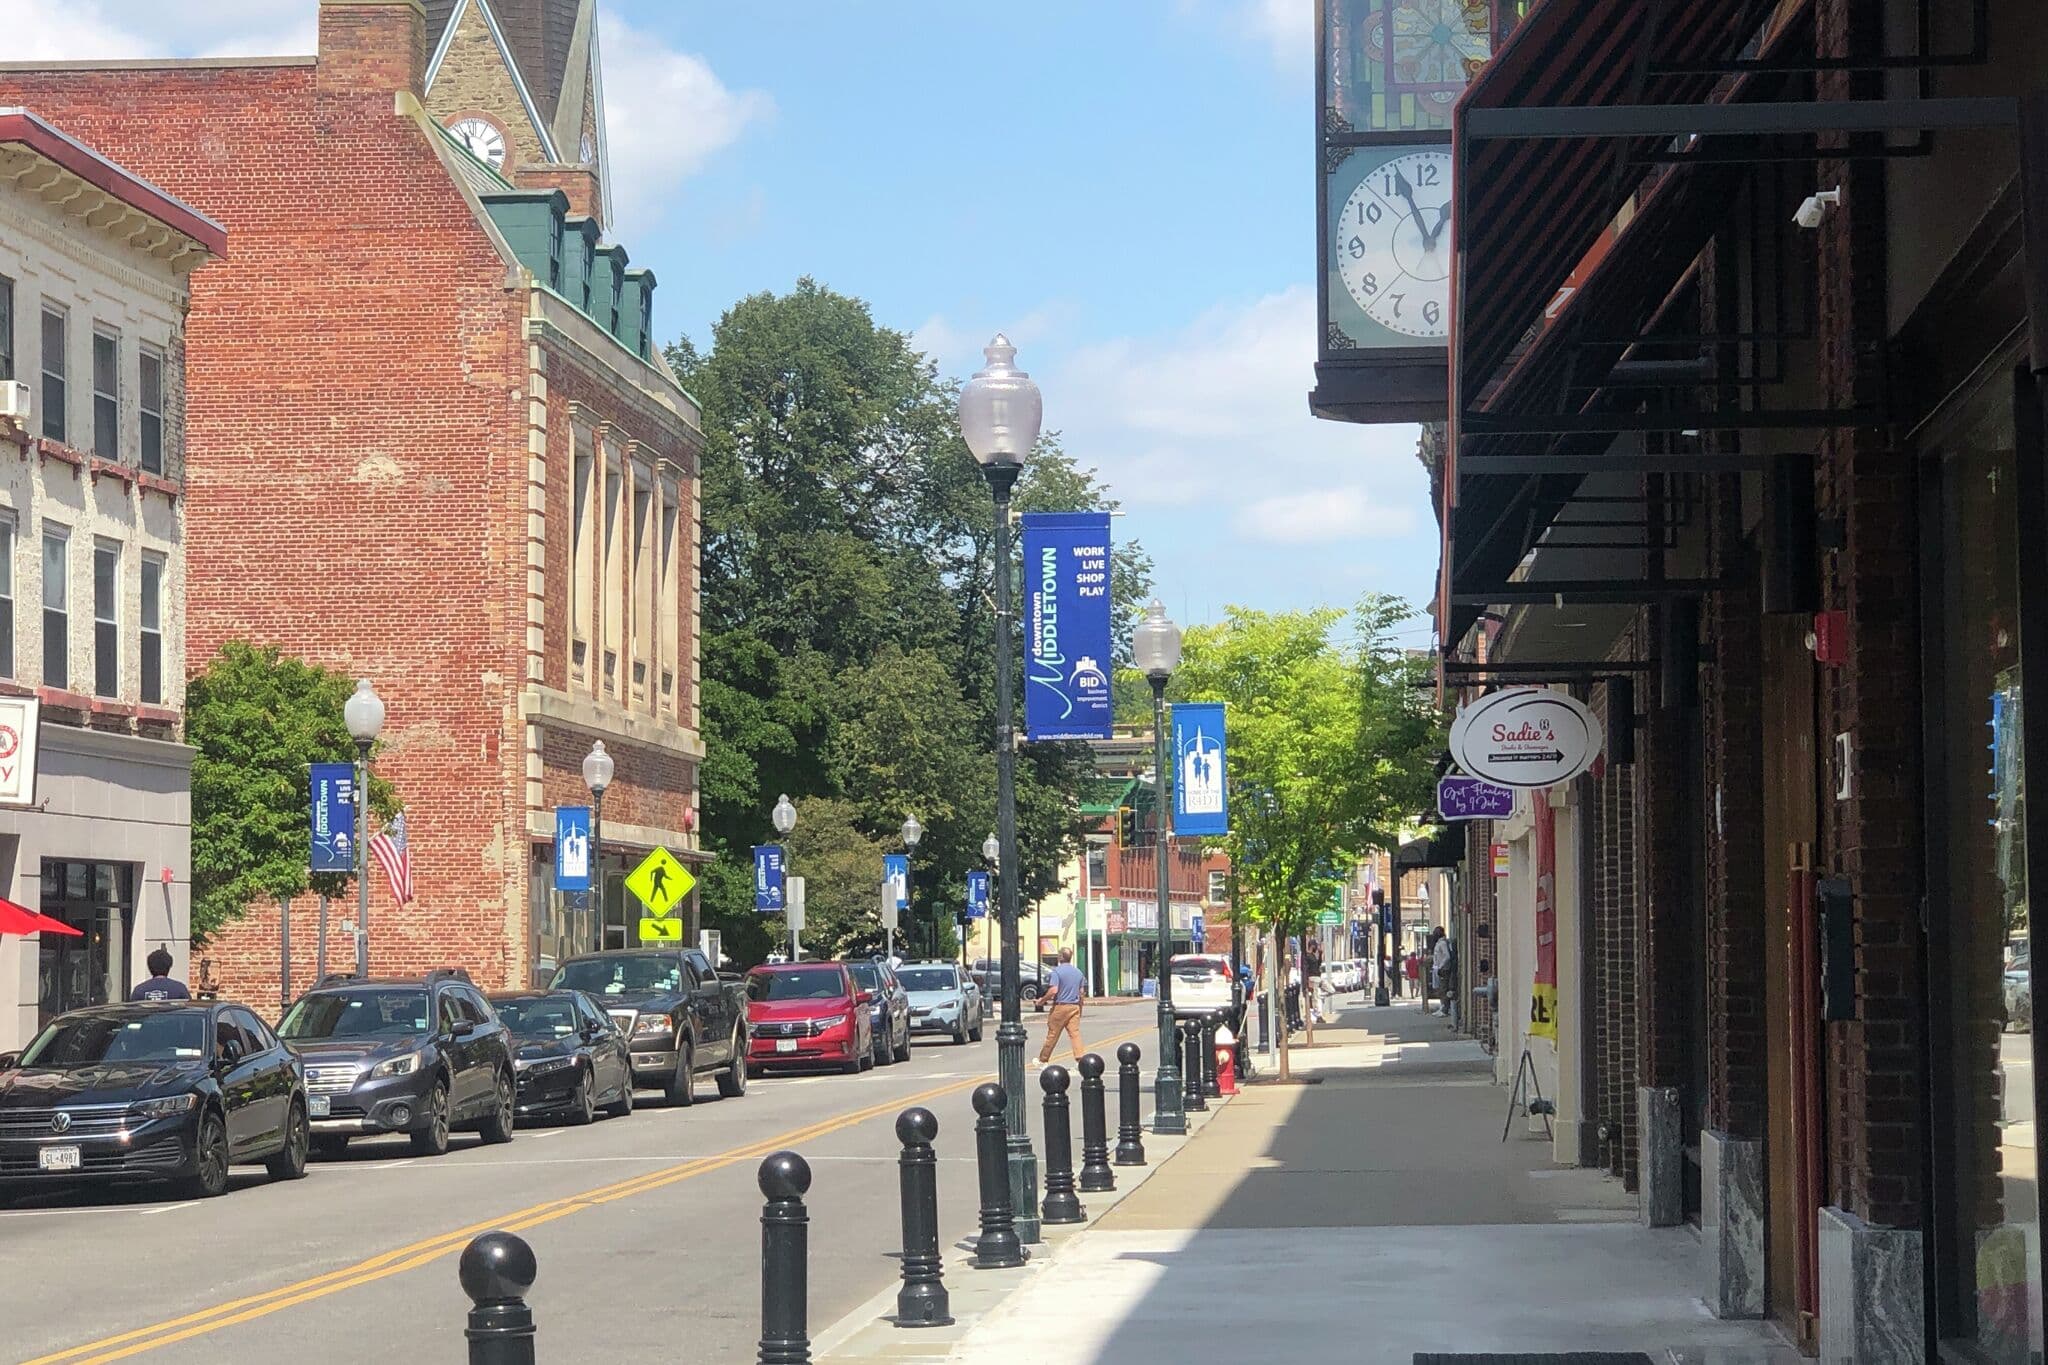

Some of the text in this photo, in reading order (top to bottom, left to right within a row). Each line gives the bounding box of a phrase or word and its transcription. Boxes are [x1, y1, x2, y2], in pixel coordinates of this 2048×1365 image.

[1416, 162, 1440, 187] 12
[1357, 201, 1382, 225] 10
[1348, 235, 1366, 259] 9
[1361, 272, 1379, 297] 8
[1389, 293, 1406, 319] 7
[1422, 300, 1440, 327] 6
[1073, 546, 1105, 556] WORK
[1082, 560, 1105, 570] LIVE
[1076, 573, 1105, 583] SHOP
[1079, 586, 1105, 597] PLAY
[1029, 547, 1072, 720] MIDDLETOWN
[1031, 591, 1042, 657] downtown
[1079, 676, 1100, 688] BID
[1492, 718, 1555, 742] Sadie's
